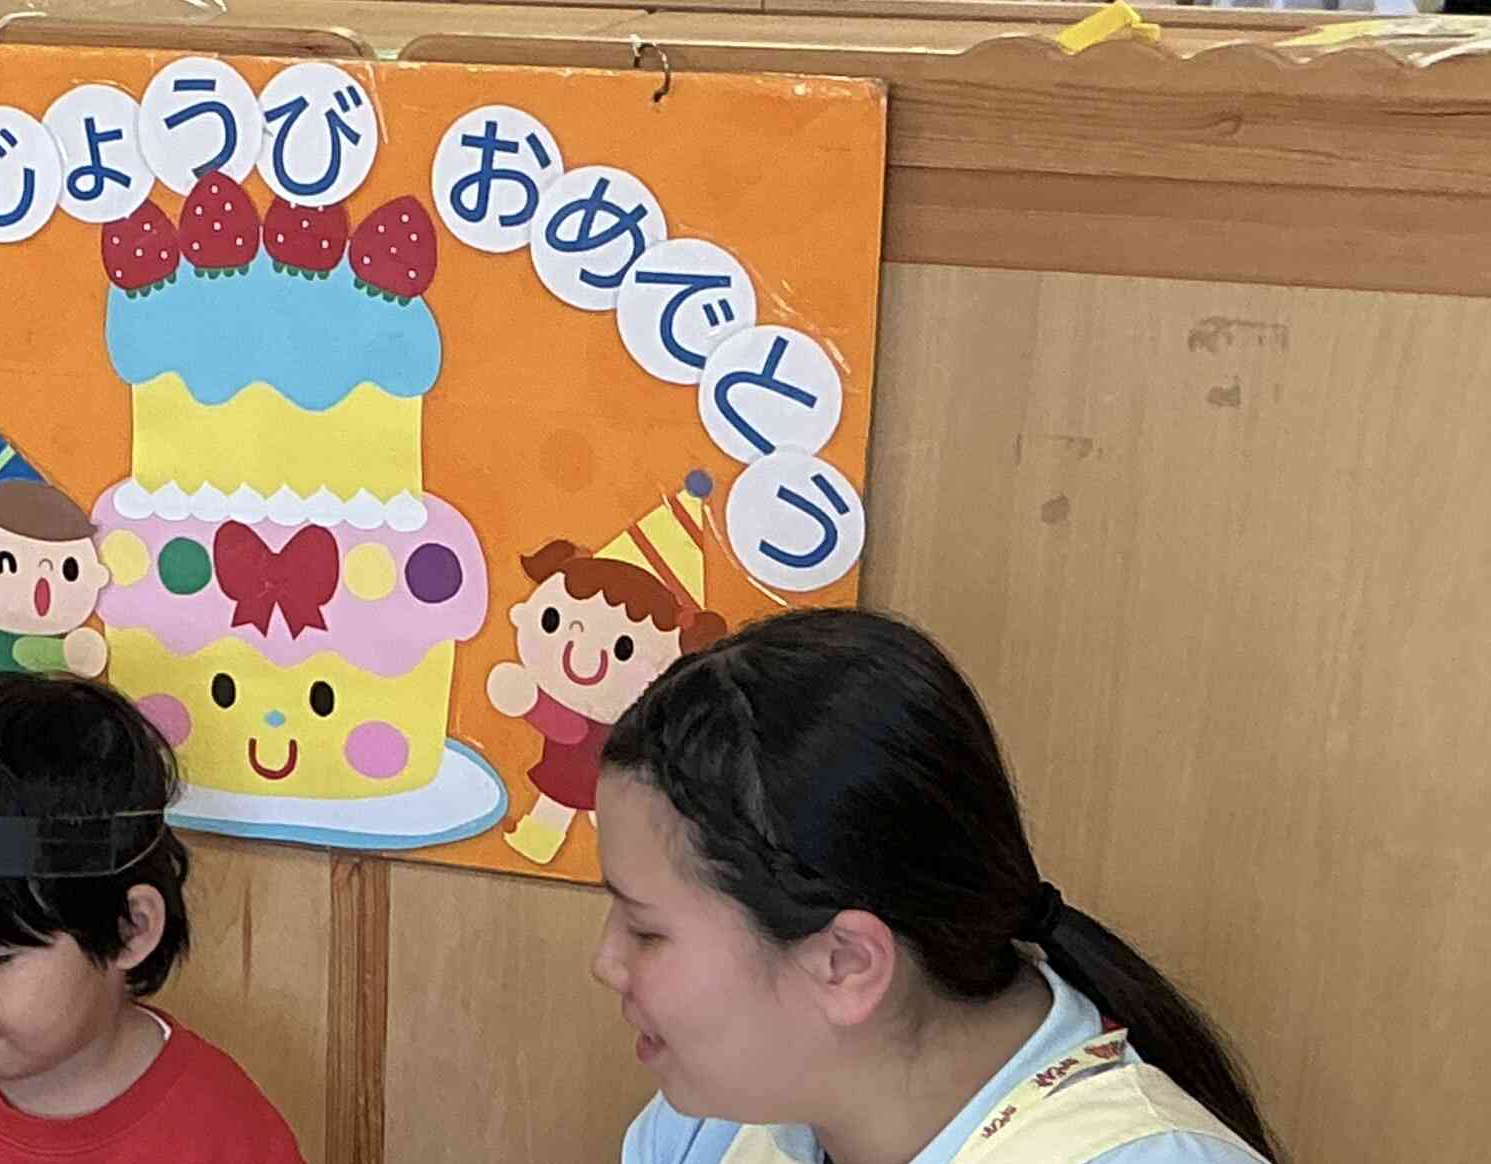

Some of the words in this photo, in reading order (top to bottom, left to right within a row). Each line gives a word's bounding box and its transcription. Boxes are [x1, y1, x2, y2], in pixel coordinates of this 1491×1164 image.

[449, 120, 851, 569] おめでとう
